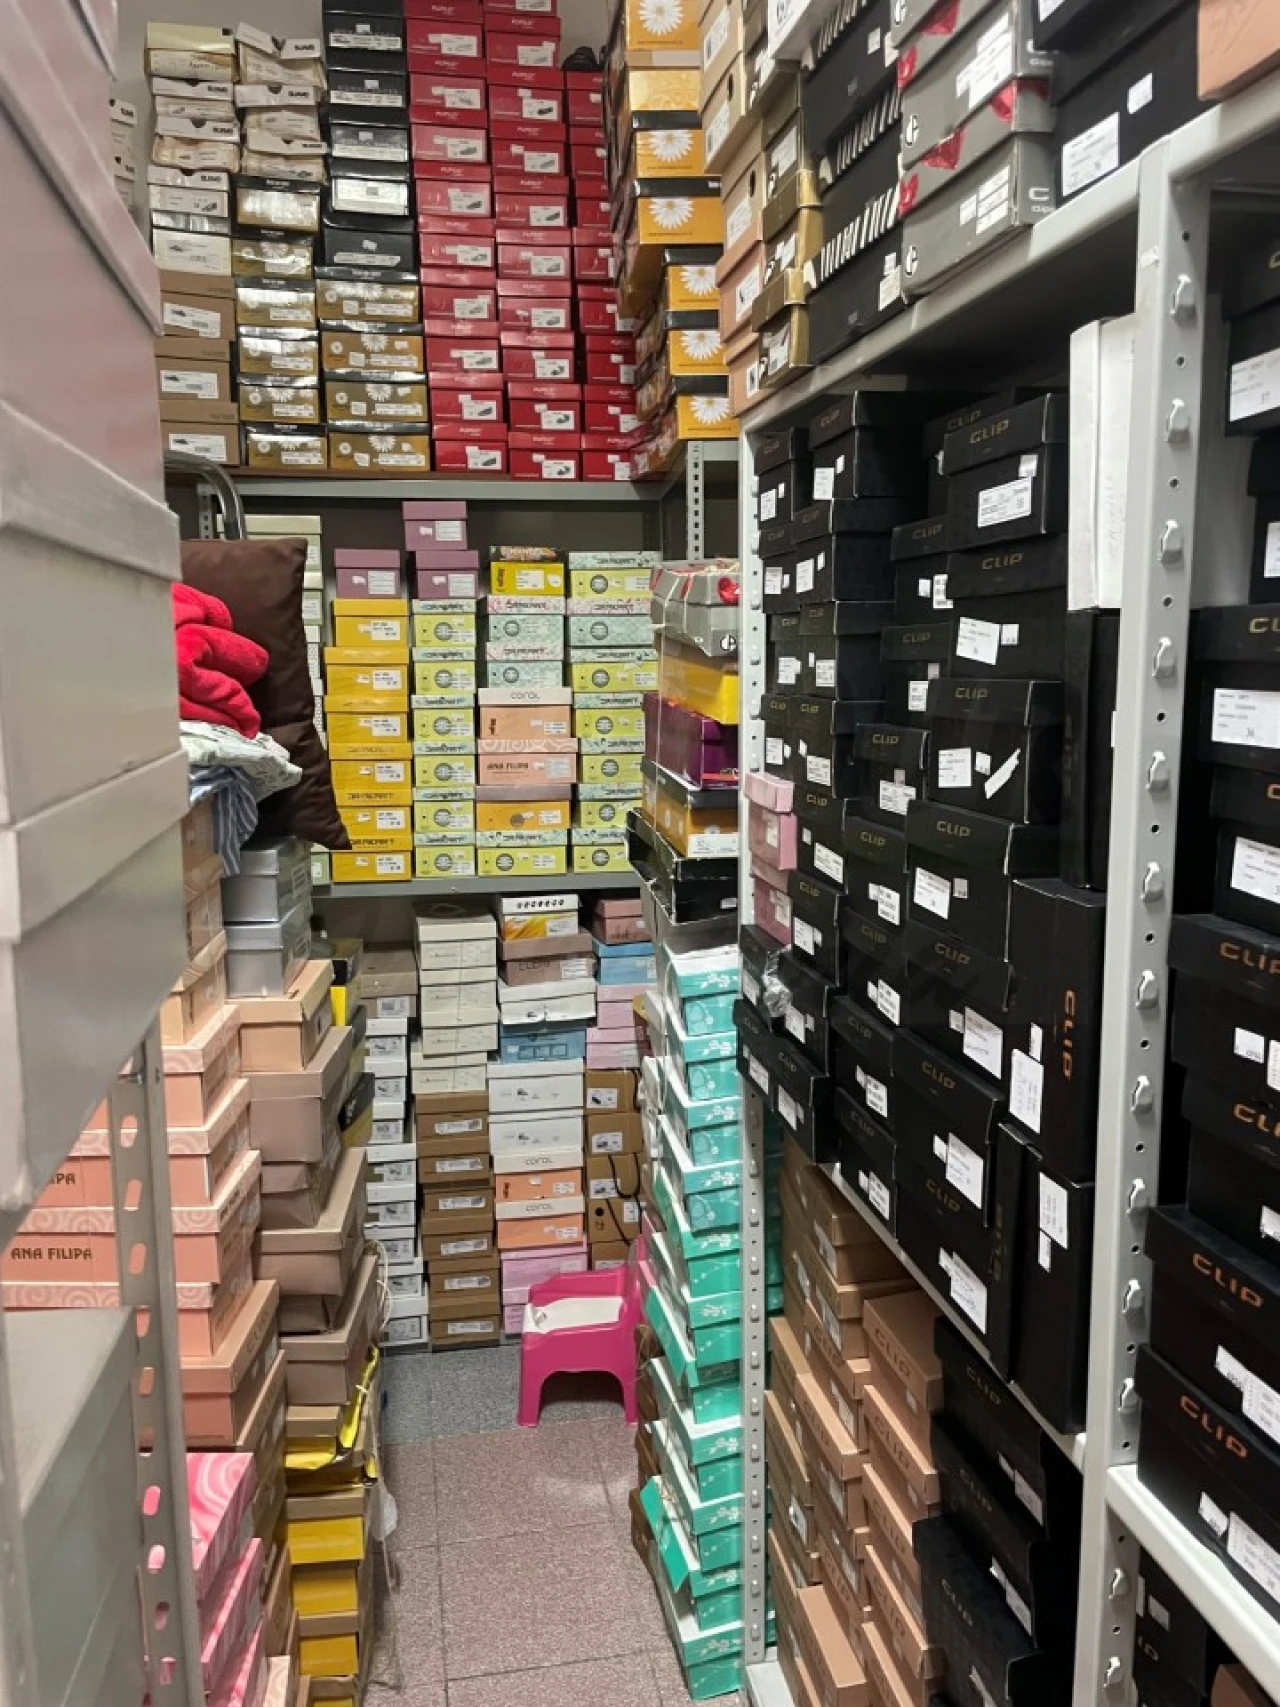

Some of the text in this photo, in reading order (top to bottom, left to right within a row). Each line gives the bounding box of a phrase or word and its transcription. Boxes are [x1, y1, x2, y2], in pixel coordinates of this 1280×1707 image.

[969, 419, 1009, 443] CLIP
[912, 524, 942, 540] CLIP
[982, 553, 1024, 570] CLIP
[902, 631, 931, 643] CLIP
[954, 687, 988, 699] CLIP
[872, 734, 899, 745] CLIP
[807, 794, 828, 807] CLIP
[860, 832, 886, 847] CLIP
[936, 820, 971, 838] CLIP
[935, 942, 971, 965] CLIP
[1062, 988, 1076, 1082] CLIP
[921, 1060, 956, 1090] CLIP
[926, 1178, 961, 1212] CLIP
[11, 1247, 92, 1260] ANA FILIPA
[1193, 1253, 1264, 1308] CLIP
[875, 1327, 911, 1378] CLIP
[967, 1364, 1001, 1406] CLIP
[1180, 1395, 1248, 1459] CLIP
[874, 1415, 909, 1469] CLIP
[942, 1579, 973, 1627] CLIP
